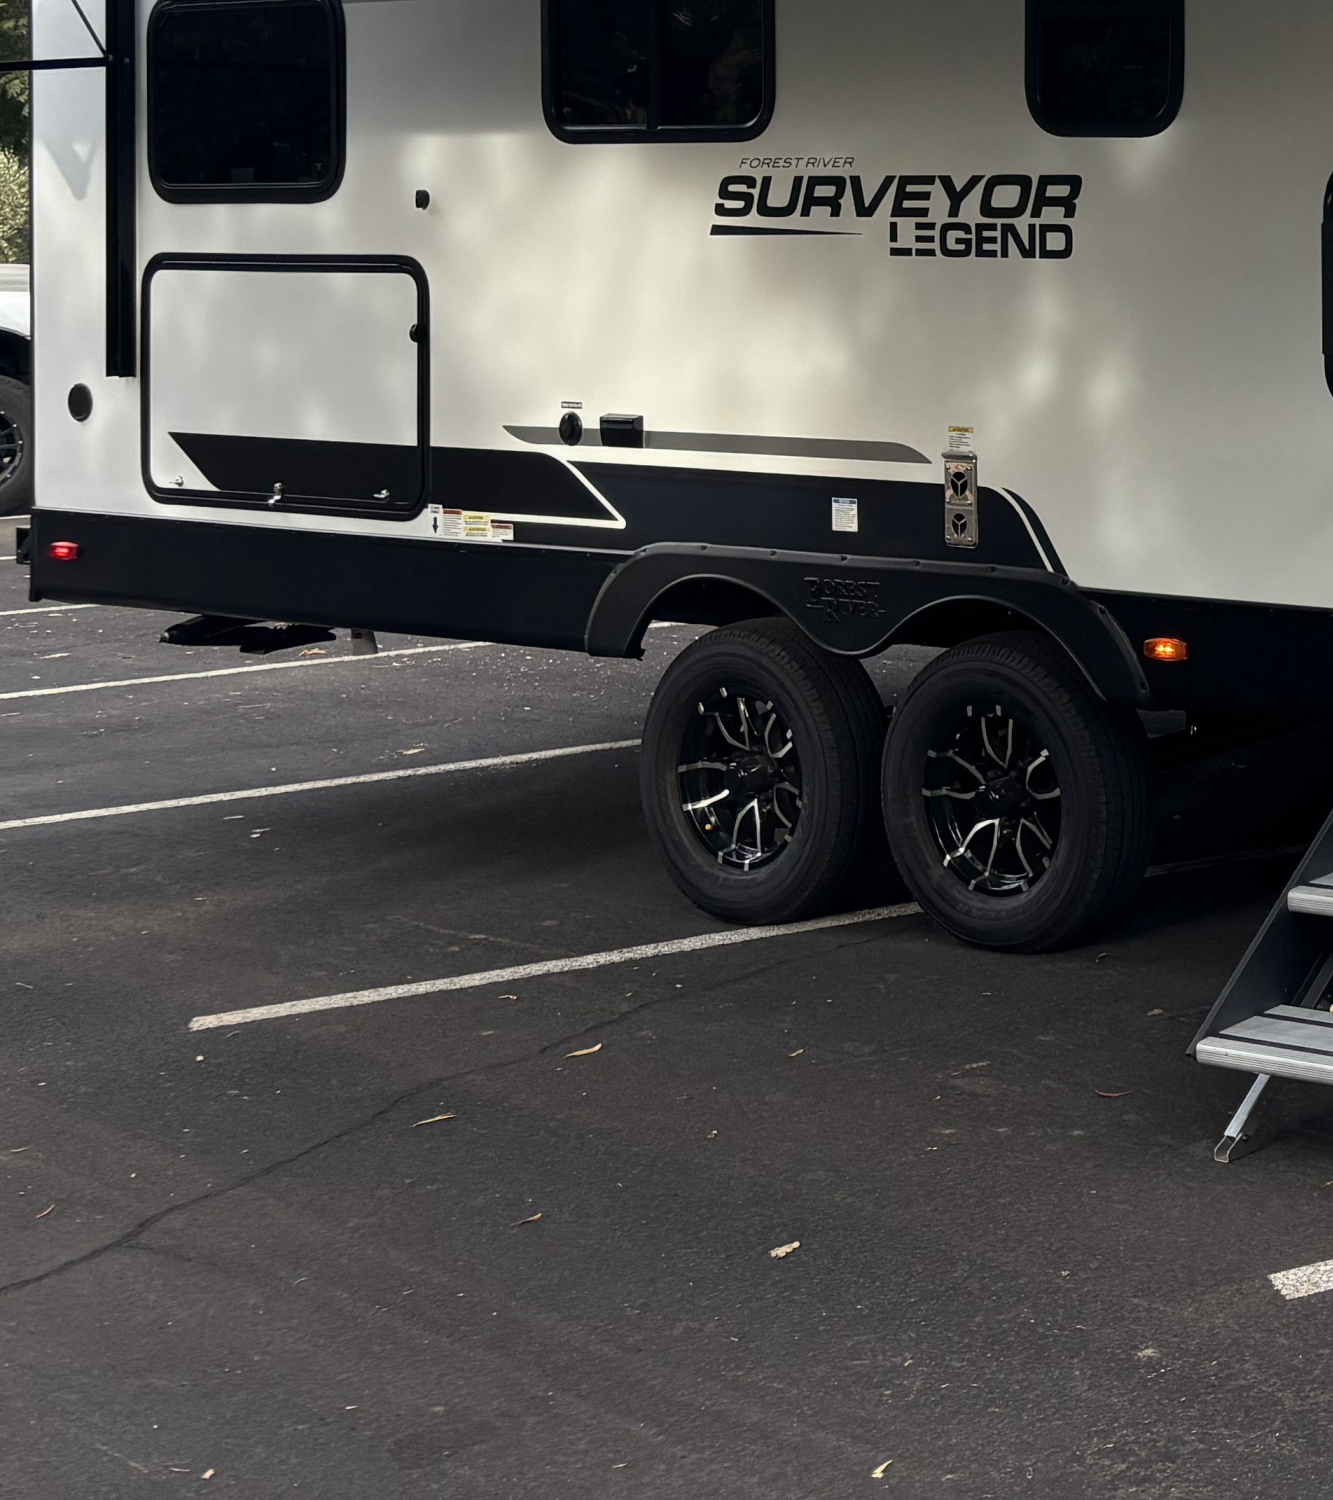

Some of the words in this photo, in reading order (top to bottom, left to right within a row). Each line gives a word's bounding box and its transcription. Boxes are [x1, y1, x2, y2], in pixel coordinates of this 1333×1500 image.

[738, 156, 804, 170] FOREST
[805, 156, 856, 169] RIVER
[714, 174, 1083, 219] SURVEYOR
[889, 221, 1074, 260] LEGEND
